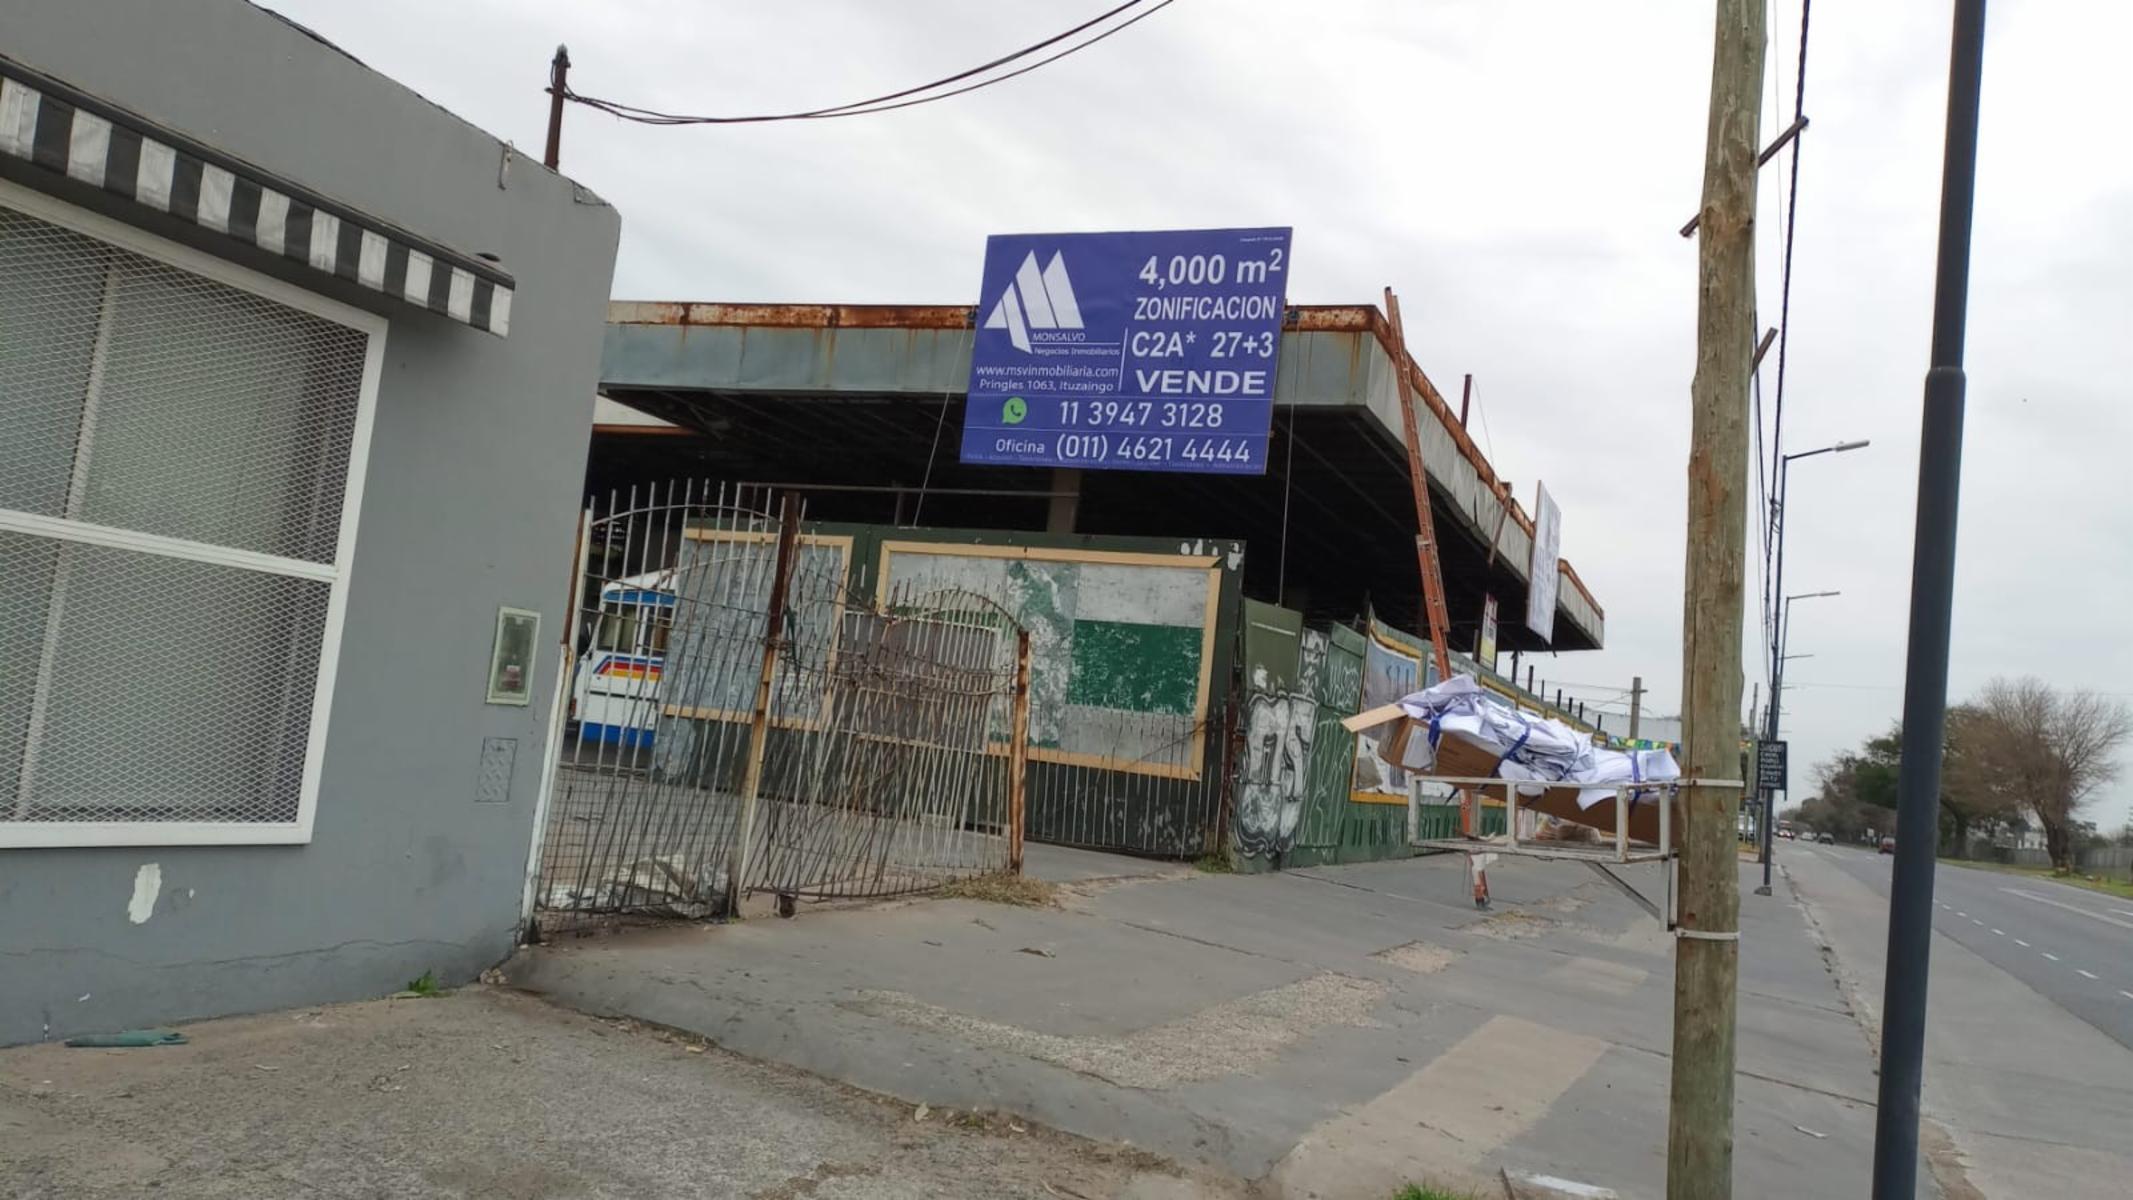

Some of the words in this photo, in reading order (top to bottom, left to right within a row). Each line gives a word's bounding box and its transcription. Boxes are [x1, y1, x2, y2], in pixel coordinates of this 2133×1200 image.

[1138, 254, 1226, 290] 4,000
[1134, 296, 1276, 320] ZONIFICACION
[1032, 332, 1086, 342] MONSALVO
[1210, 331, 1274, 358] 27+3
[1033, 347, 1069, 356] Negocios
[1071, 347, 1121, 356] Inmobiliarios
[976, 364, 1119, 378] www.msvinmobiliaria.com
[1135, 369, 1267, 394] VENDE
[980, 379, 1024, 392] Pringles
[1028, 380, 1057, 391] 1063,
[1060, 401, 1080, 425] 11
[1088, 402, 1153, 426] 3947
[1161, 403, 1224, 427] 3128
[995, 438, 1046, 454] Oficina
[1056, 433, 1109, 462] (011)
[1117, 437, 1173, 460] 4621
[1182, 438, 1250, 462] 4444
